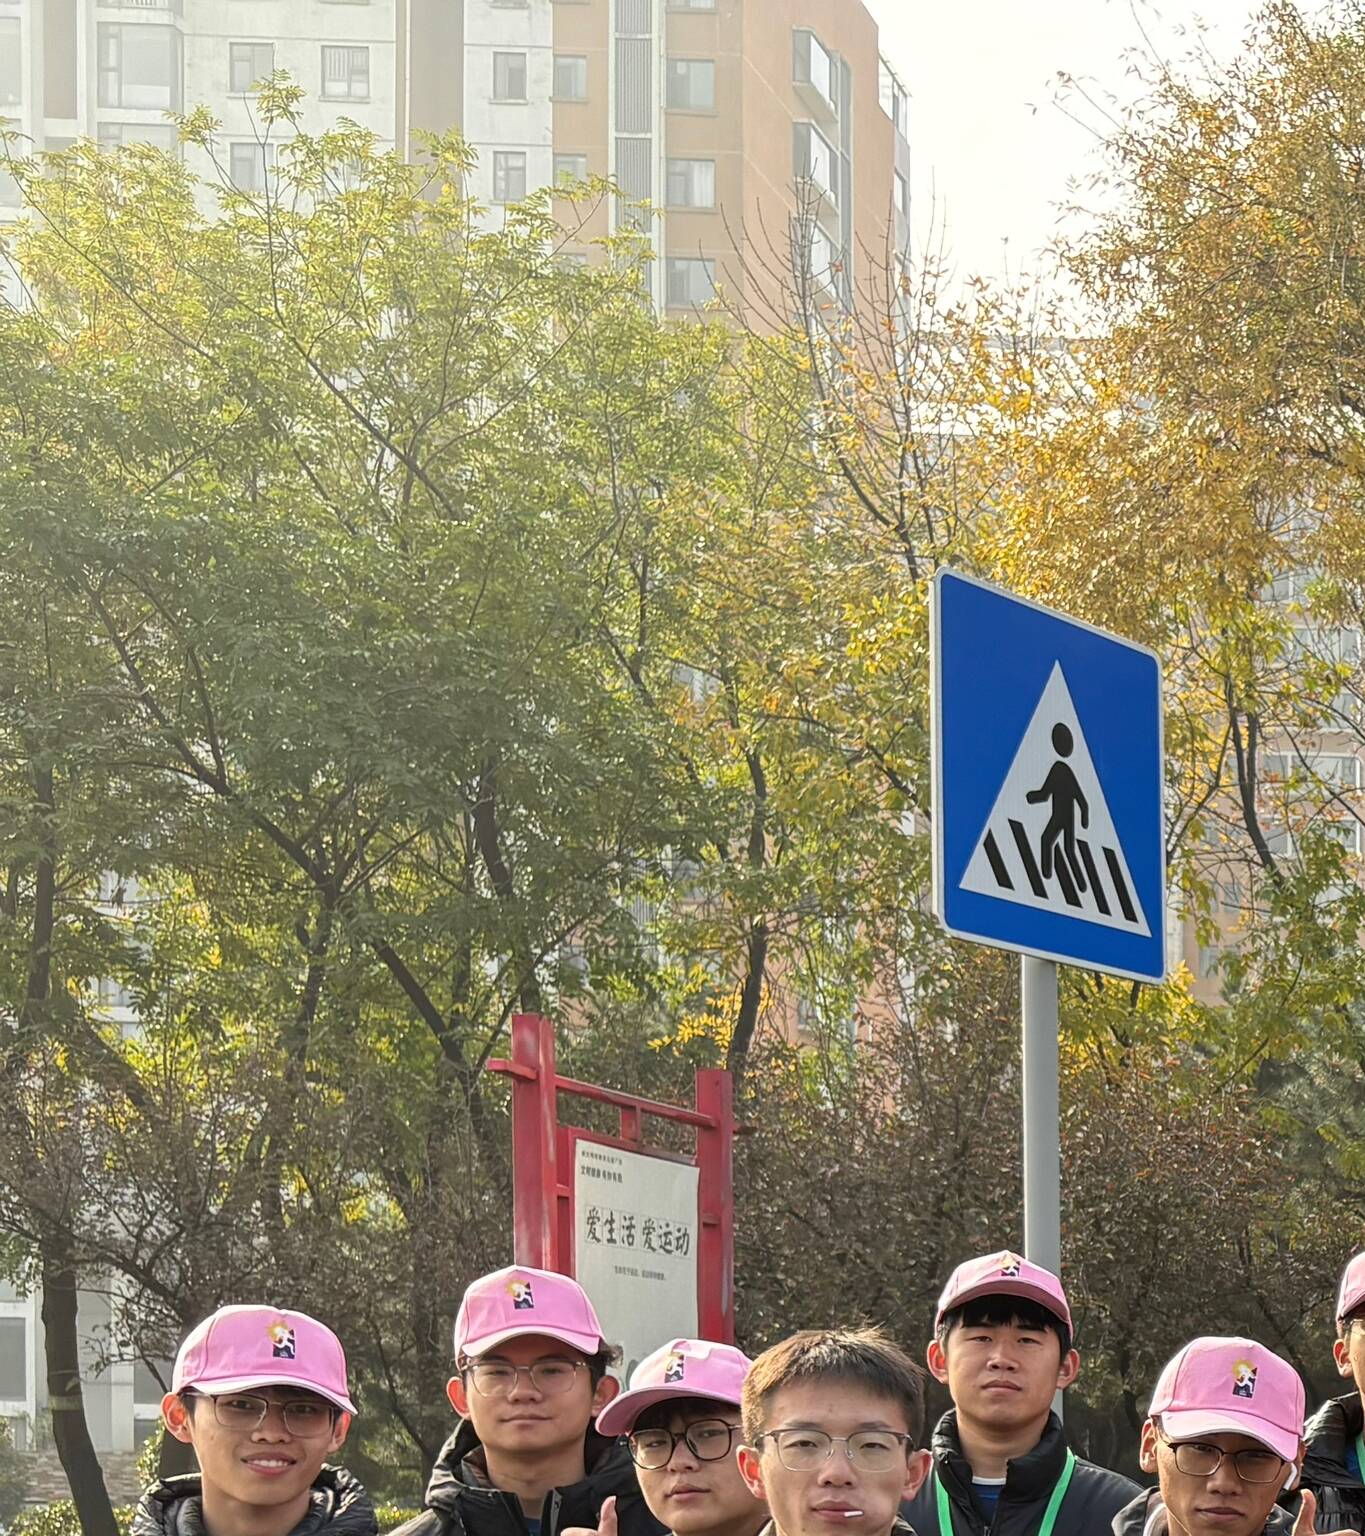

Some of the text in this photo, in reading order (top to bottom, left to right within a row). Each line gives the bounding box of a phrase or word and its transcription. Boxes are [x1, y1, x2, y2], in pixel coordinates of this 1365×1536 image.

[586, 1206, 690, 1256] 爱生活 爱运动
